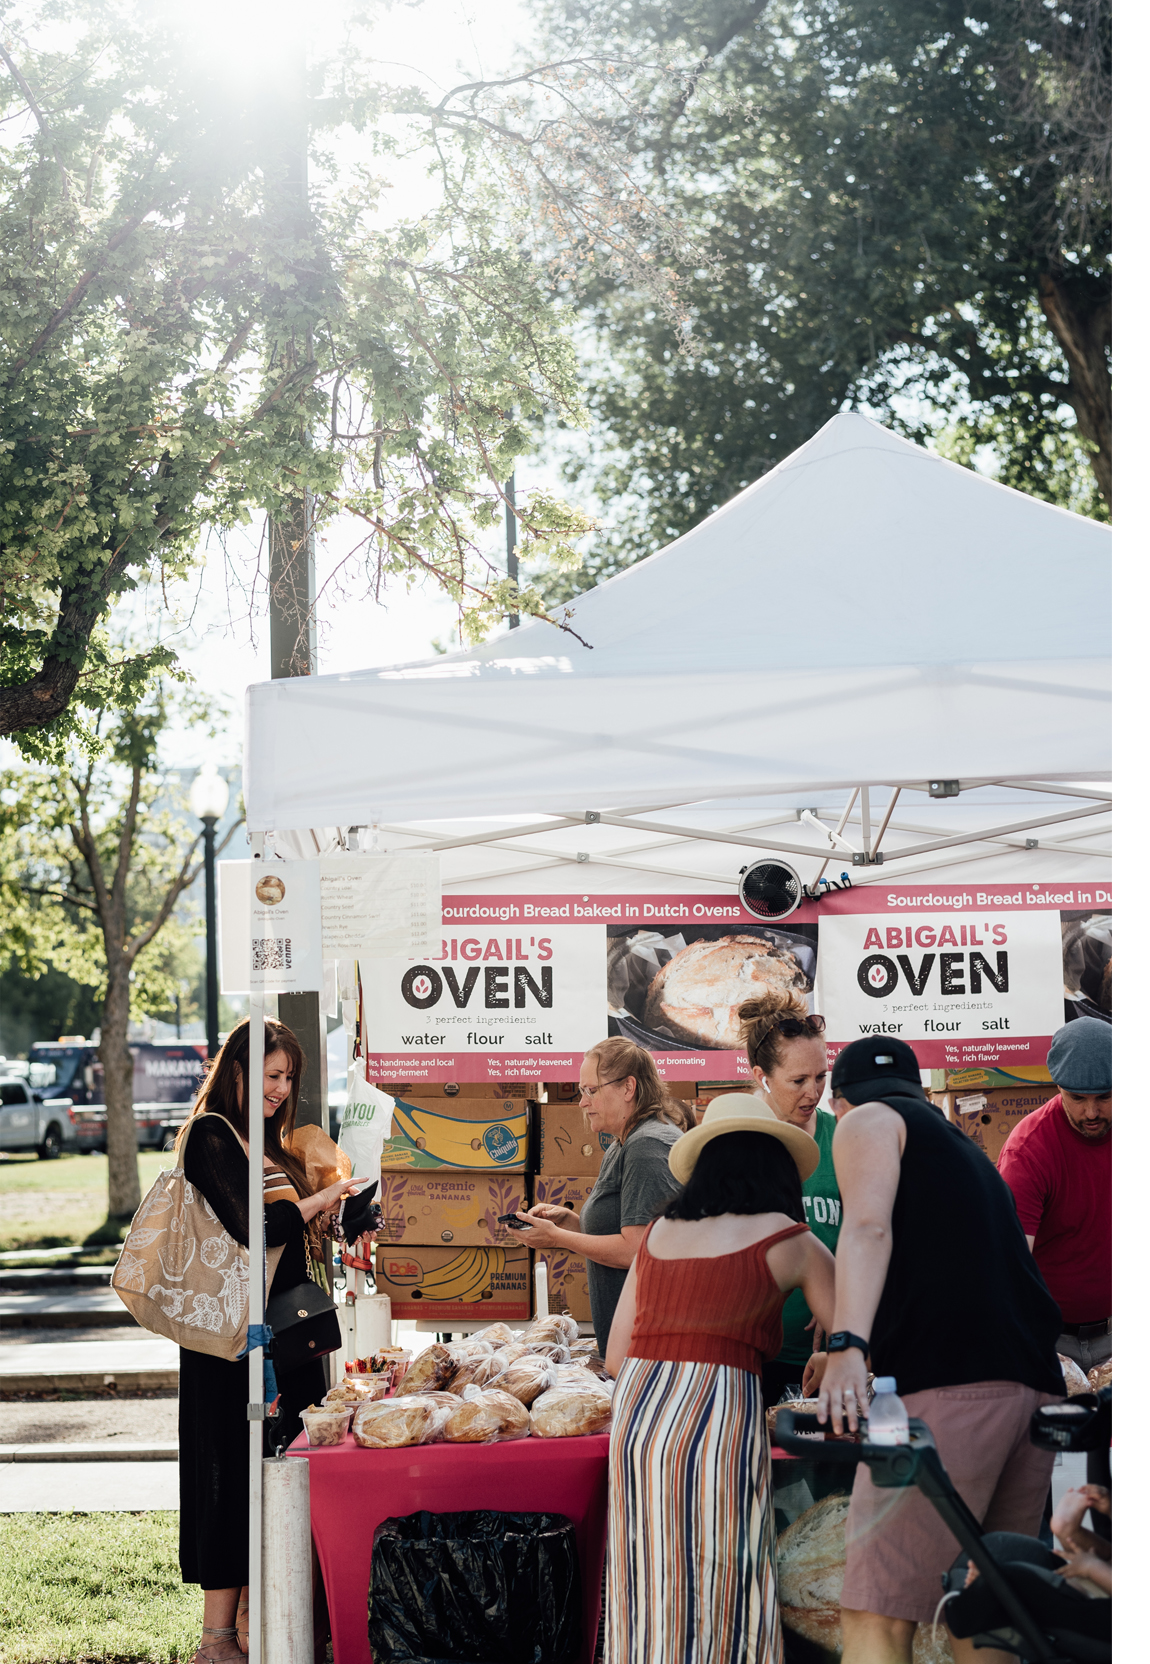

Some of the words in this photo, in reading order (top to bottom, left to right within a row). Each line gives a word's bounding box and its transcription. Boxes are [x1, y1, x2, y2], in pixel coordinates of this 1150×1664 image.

[887, 893, 973, 908] Sourdough
[976, 891, 1022, 906] Bread
[1026, 891, 1075, 905] baked
[1077, 890, 1092, 902] in
[523, 903, 570, 917] Bread
[573, 903, 622, 917] baked
[625, 903, 639, 917] in
[643, 903, 688, 917] Dutch
[691, 904, 741, 917] Ovens
[863, 923, 1008, 950] ABIGAIL'S
[408, 936, 554, 960] BIGAIL'S
[857, 951, 1010, 998] OVEN
[401, 964, 554, 1009] OVEN
[882, 1003, 889, 1013] 3
[892, 1003, 929, 1014] perfect
[932, 1001, 993, 1013] ingredients
[426, 1016, 432, 1024] 3
[435, 1015, 473, 1026] perfect
[476, 1015, 537, 1026] ingredients
[859, 1021, 903, 1034] water
[923, 1018, 962, 1032] flour
[981, 1017, 1010, 1030] salt
[401, 1033, 446, 1045] water
[466, 1032, 505, 1045] flour
[524, 1032, 553, 1045] salt
[945, 1045, 960, 1053] Yes,
[962, 1044, 994, 1053] naturally
[996, 1042, 1030, 1051] leavened
[368, 1058, 380, 1068] Yes,
[380, 1058, 420, 1067] handmade
[421, 1058, 436, 1067] and
[437, 1058, 454, 1067] local
[487, 1058, 502, 1067] Yes,
[504, 1058, 538, 1068] naturally
[538, 1058, 573, 1066] leavened
[666, 1057, 706, 1067] bromating
[736, 1056, 750, 1066] No,
[945, 1055, 960, 1063] Yes,
[962, 1053, 977, 1062] rich
[978, 1053, 1000, 1061] flavor
[369, 1068, 380, 1077] Yes,
[380, 1068, 429, 1079] long-ferment
[487, 1068, 502, 1077] Yes,
[505, 1068, 520, 1077] rich
[521, 1068, 542, 1077] flavor
[736, 1066, 750, 1075] No,
[1001, 1095, 1049, 1109] organic
[352, 1102, 376, 1121] YOU
[1006, 1108, 1036, 1116] BANAN
[489, 1137, 518, 1159] Chiquita
[427, 1181, 476, 1193] organic
[406, 1189, 426, 1197] Harvest
[429, 1193, 471, 1201] BANANAS
[389, 1262, 419, 1276] Dole
[490, 1272, 527, 1281] PREMIUM
[490, 1281, 527, 1291] BANANAS
